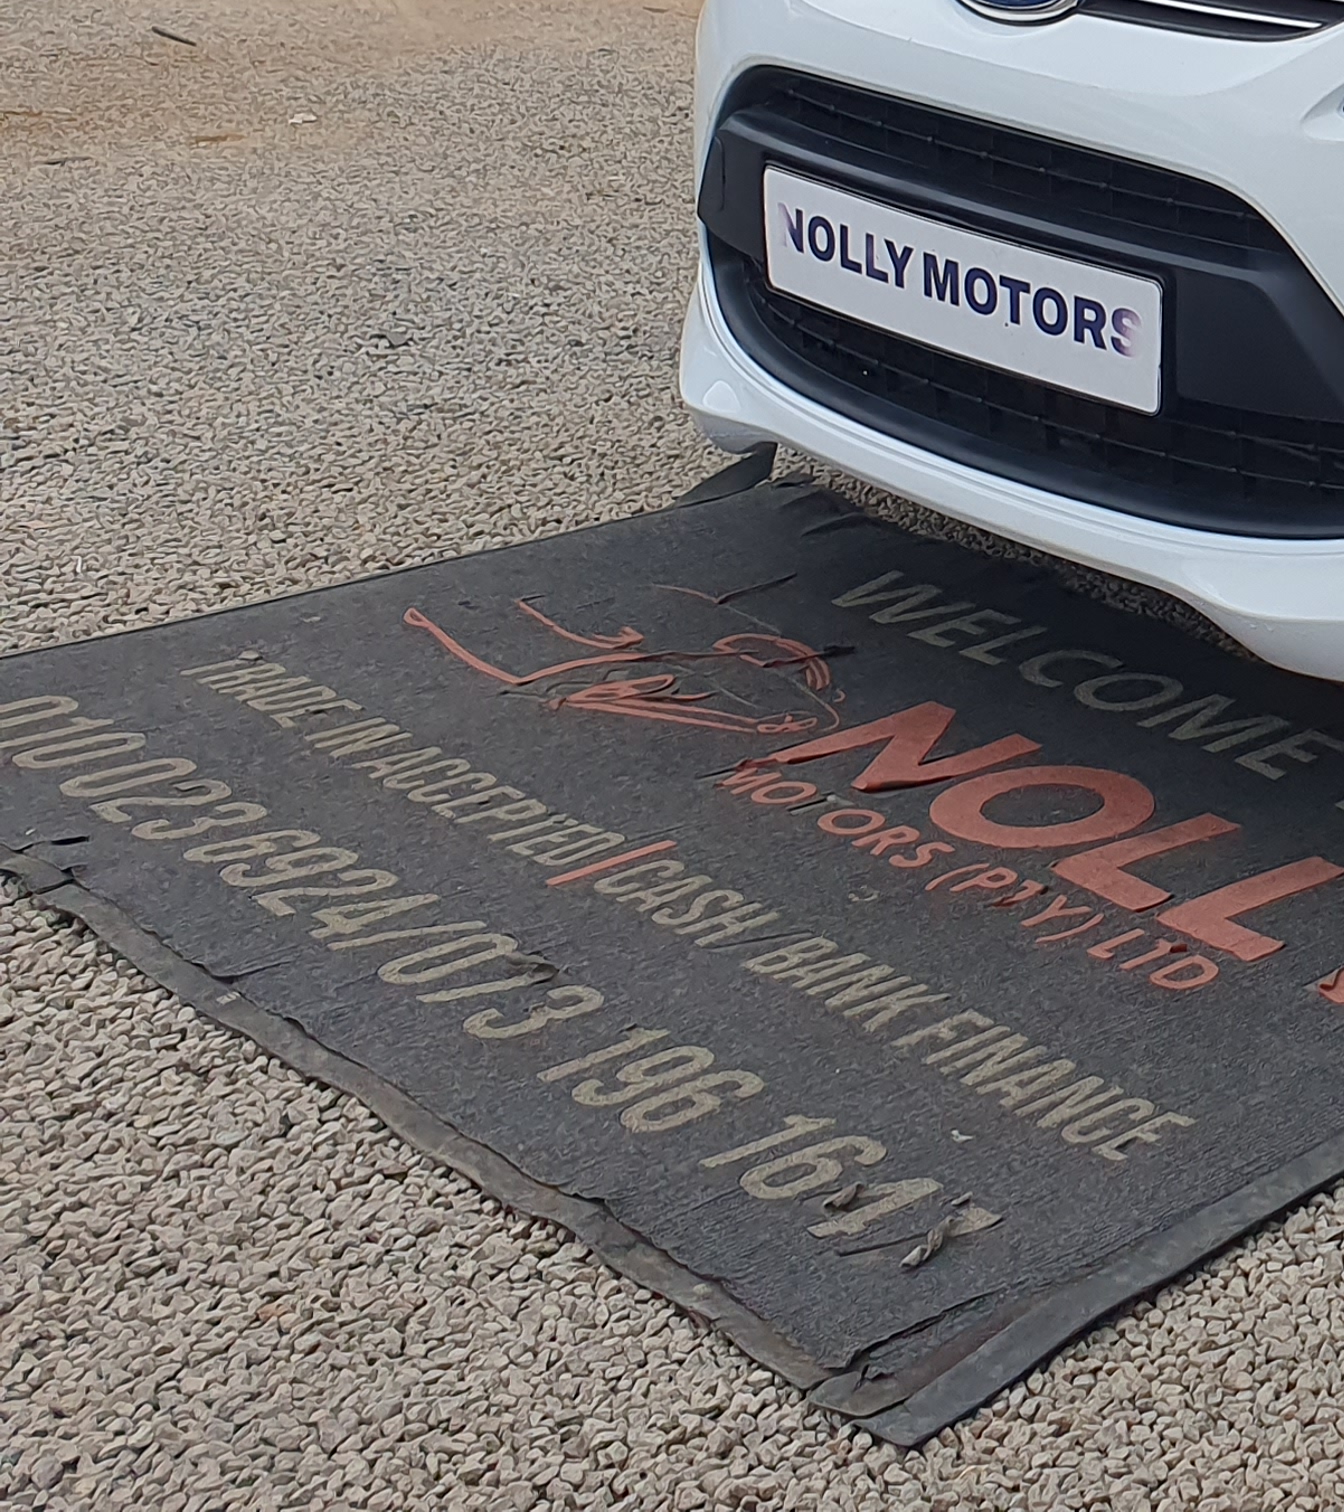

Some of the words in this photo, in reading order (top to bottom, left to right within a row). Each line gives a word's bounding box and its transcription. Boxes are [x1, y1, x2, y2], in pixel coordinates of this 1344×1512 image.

[777, 201, 913, 289] NOLLY
[922, 251, 1143, 359] MOTORS
[180, 651, 365, 729] TRADE
[303, 717, 413, 759] IN
[890, 1010, 1197, 1162] FINANCE
[1085, 928, 1220, 989] LTD
[537, 1024, 765, 1134] 196
